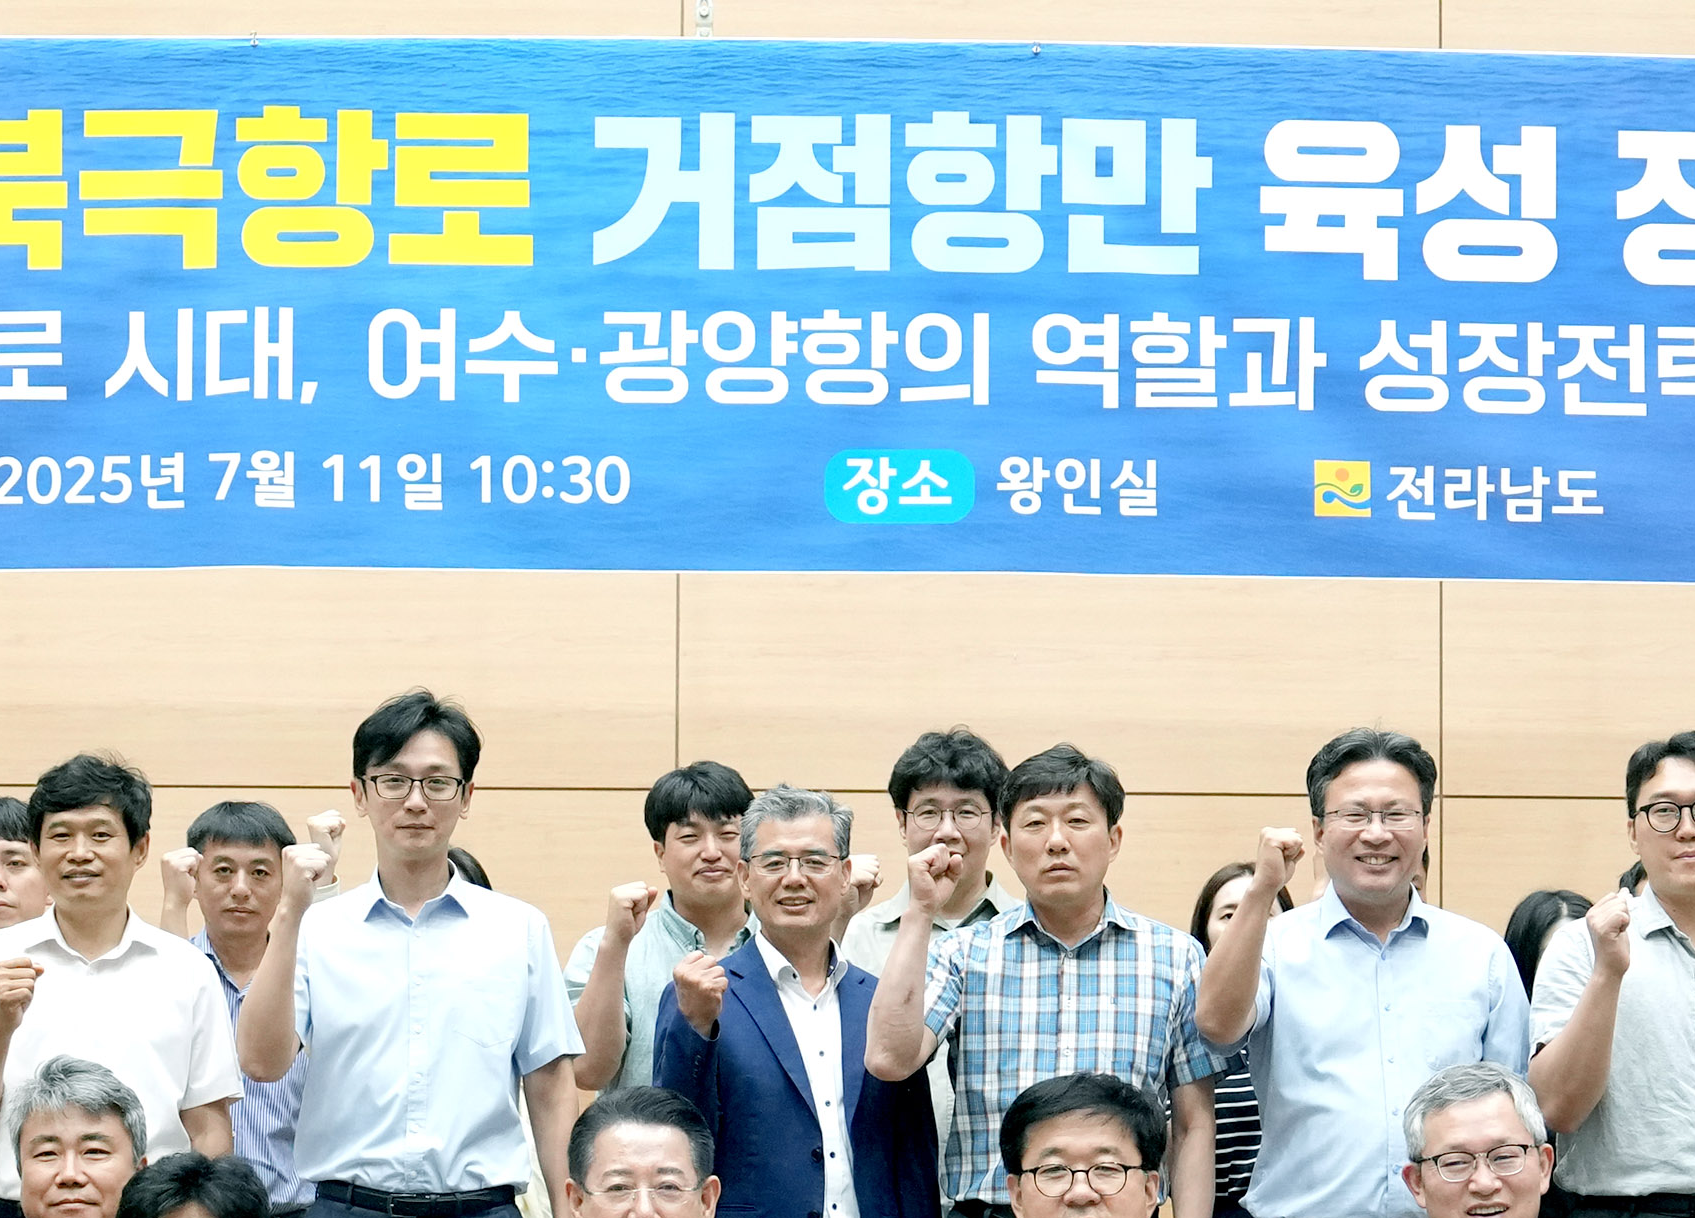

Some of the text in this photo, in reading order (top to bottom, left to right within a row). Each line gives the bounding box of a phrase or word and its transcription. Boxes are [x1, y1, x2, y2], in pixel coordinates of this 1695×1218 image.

[592, 111, 1213, 275] 거점항만
[1260, 119, 1558, 282] 육성
[105, 306, 318, 405] 시대,
[368, 307, 990, 406] 여수·광양항의
[1031, 312, 1326, 410] 역할과
[208, 449, 295, 508] 7월
[322, 453, 443, 511] 11일
[470, 454, 631, 505] 10:30
[843, 456, 1158, 517] 장소 왕인실
[1386, 465, 1604, 522] 전라남도
